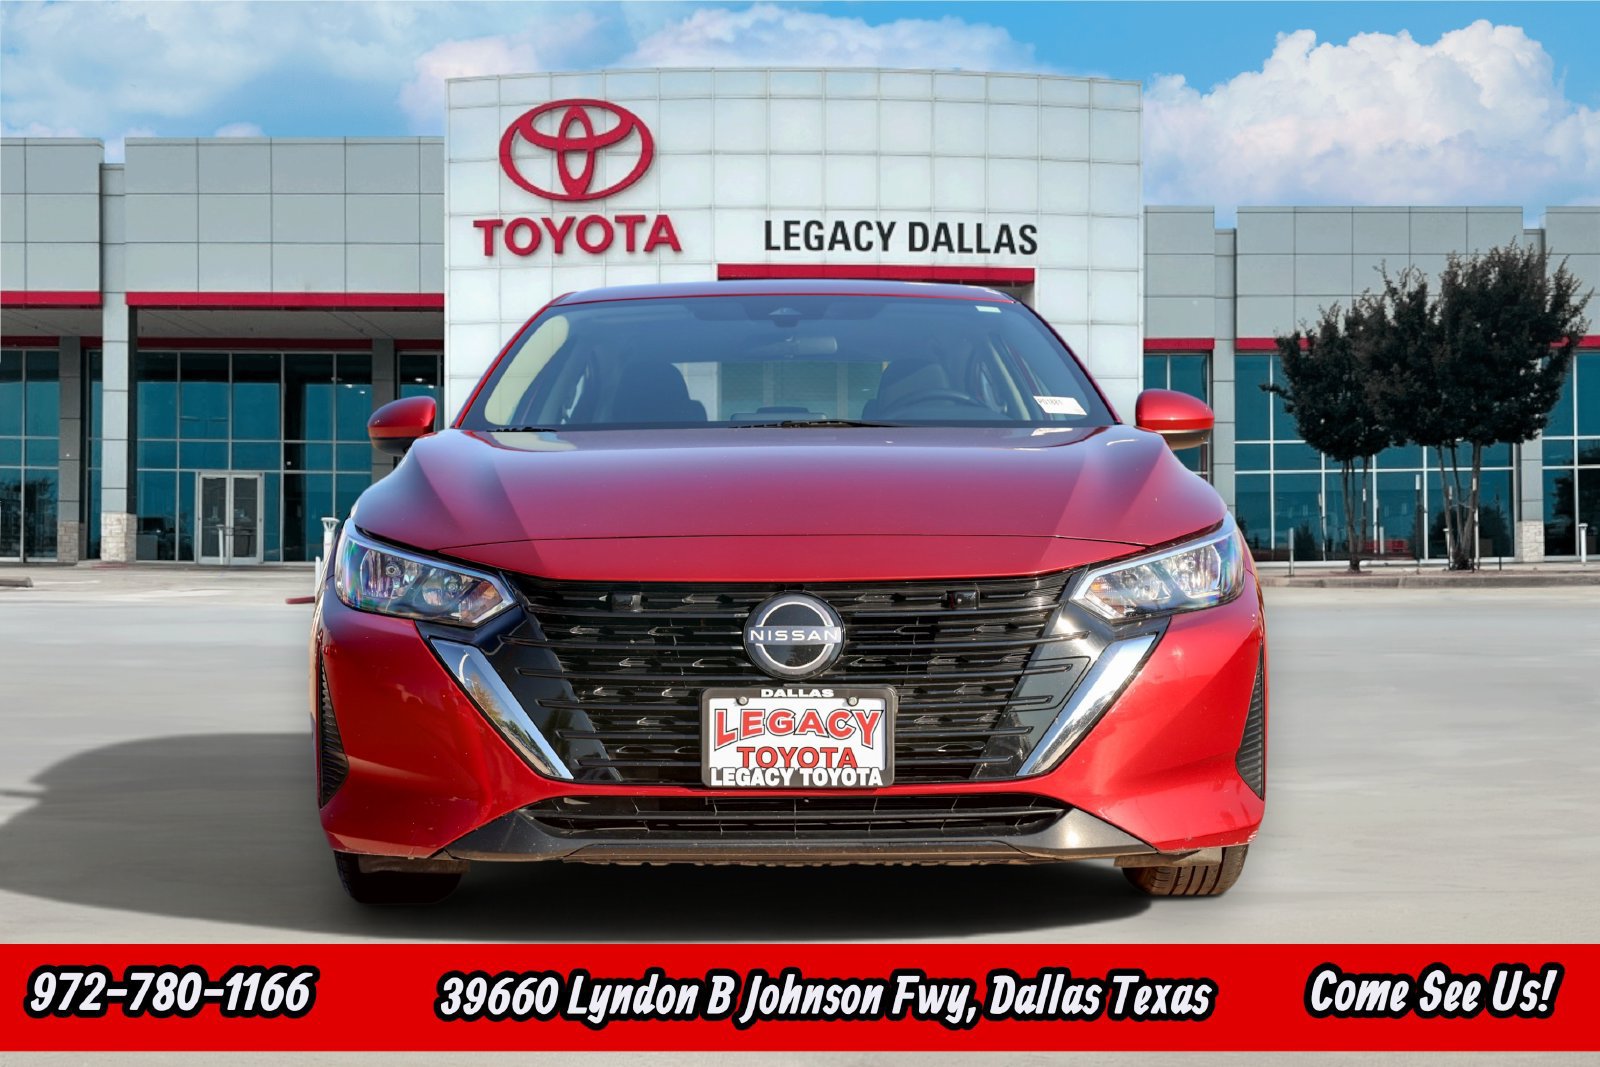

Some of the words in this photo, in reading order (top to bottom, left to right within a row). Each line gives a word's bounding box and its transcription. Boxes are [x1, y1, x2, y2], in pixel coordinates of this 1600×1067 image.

[474, 214, 682, 257] TOYOTA
[765, 220, 896, 252] LEGACY
[908, 221, 1038, 255] DALLAS
[749, 628, 838, 642] NISSAN
[760, 688, 835, 698] DALLAS
[714, 708, 884, 752] LEGACY
[736, 746, 858, 769] TOYOTA
[709, 767, 797, 787] LEGACY
[799, 767, 884, 787] TOYOTA
